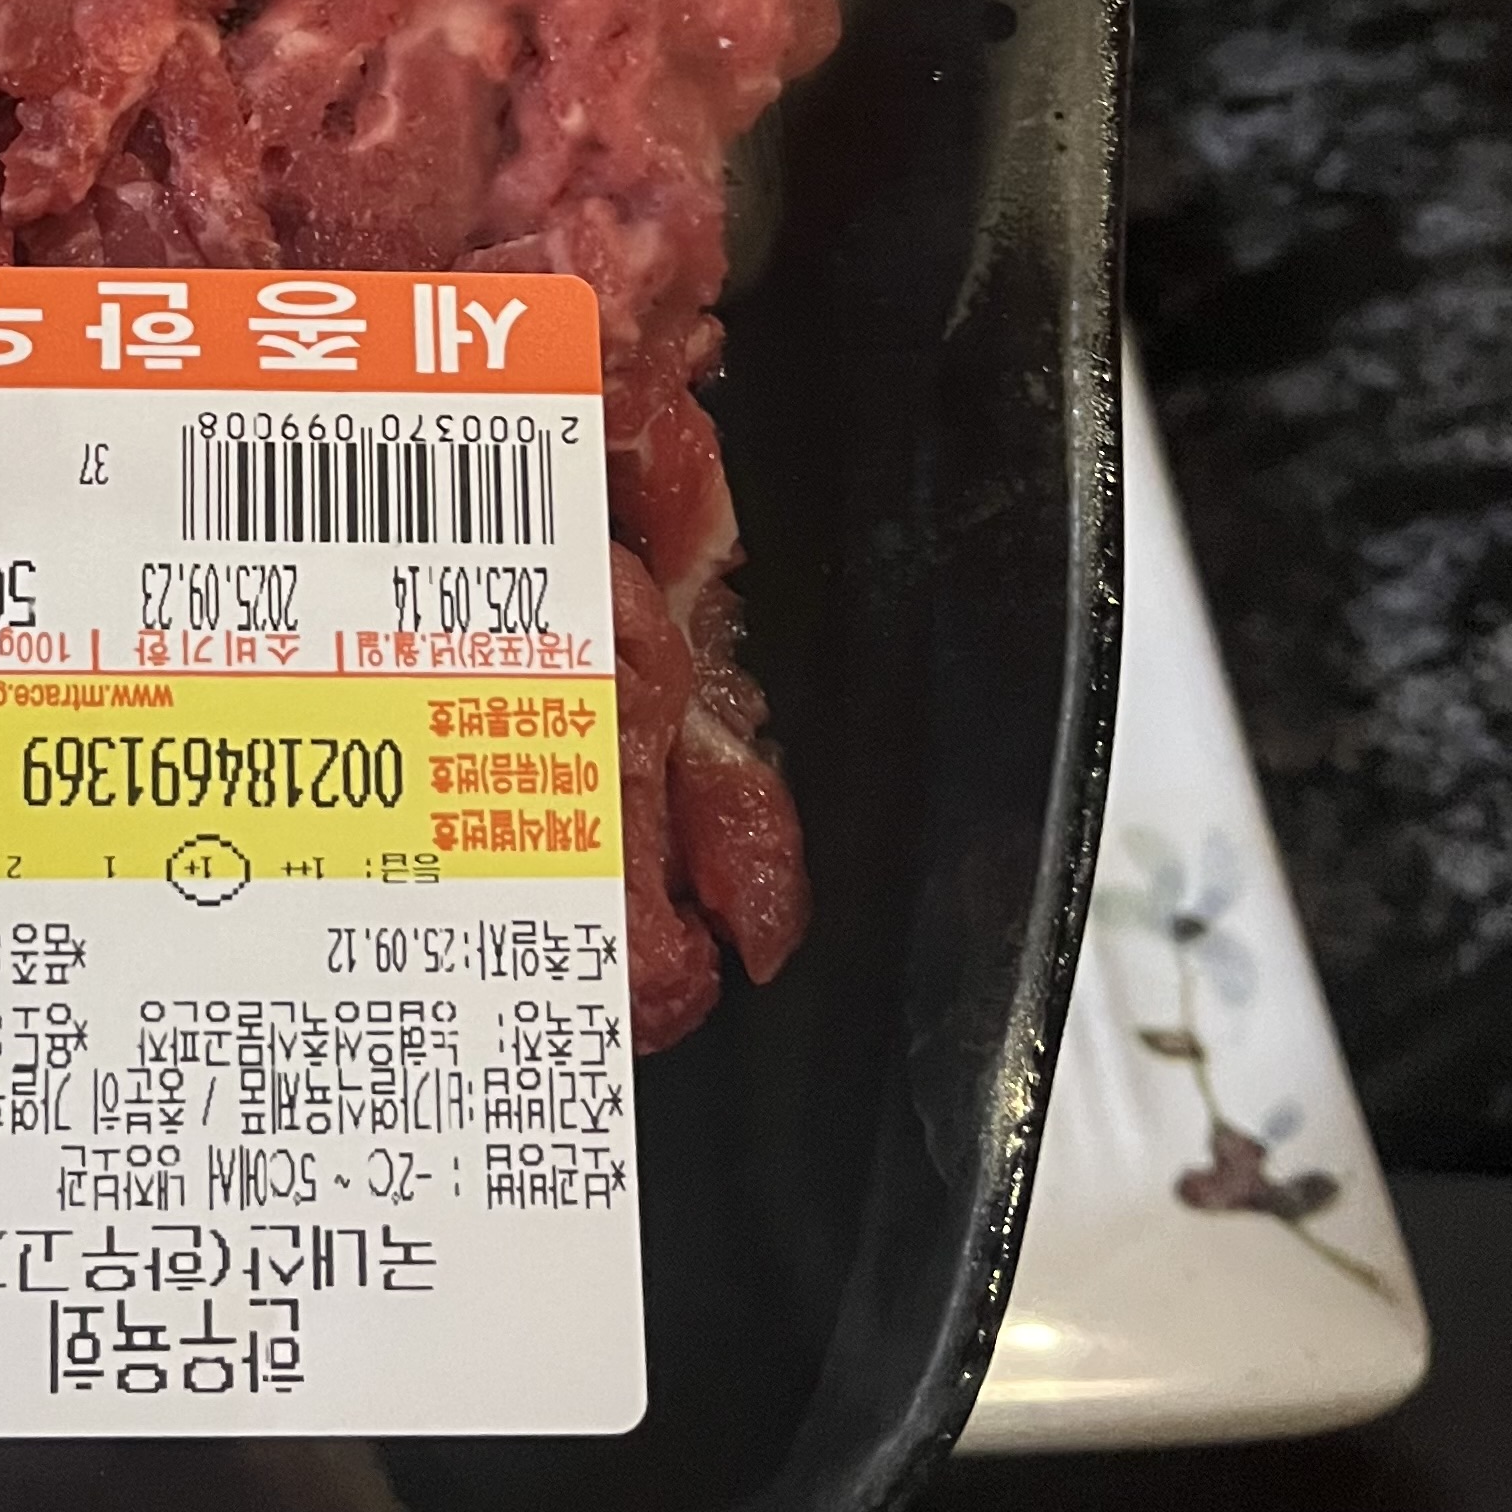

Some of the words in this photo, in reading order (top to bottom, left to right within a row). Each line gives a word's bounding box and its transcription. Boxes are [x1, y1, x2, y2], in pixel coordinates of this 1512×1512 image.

[561, 417, 579, 444] 2
[79, 443, 110, 485] 37
[141, 563, 298, 631] 2025.09.23
[393, 566, 549, 632] 2025.09.14
[428, 697, 597, 738] 수입유통번호
[23, 737, 403, 808] 002184691369
[429, 753, 599, 796] 이력(묶음)번호
[430, 809, 601, 853] 개체식별번호
[6, 856, 23, 878] 2
[103, 856, 117, 878] 1
[184, 856, 213, 879] 1+
[280, 856, 325, 879] 1++
[137, 1001, 458, 1067] 농협음성축산물공판장
[93, 1068, 186, 1134] 충분히
[56, 1145, 186, 1211] 냉장보관
[49, 1299, 305, 1395] 한우육회
